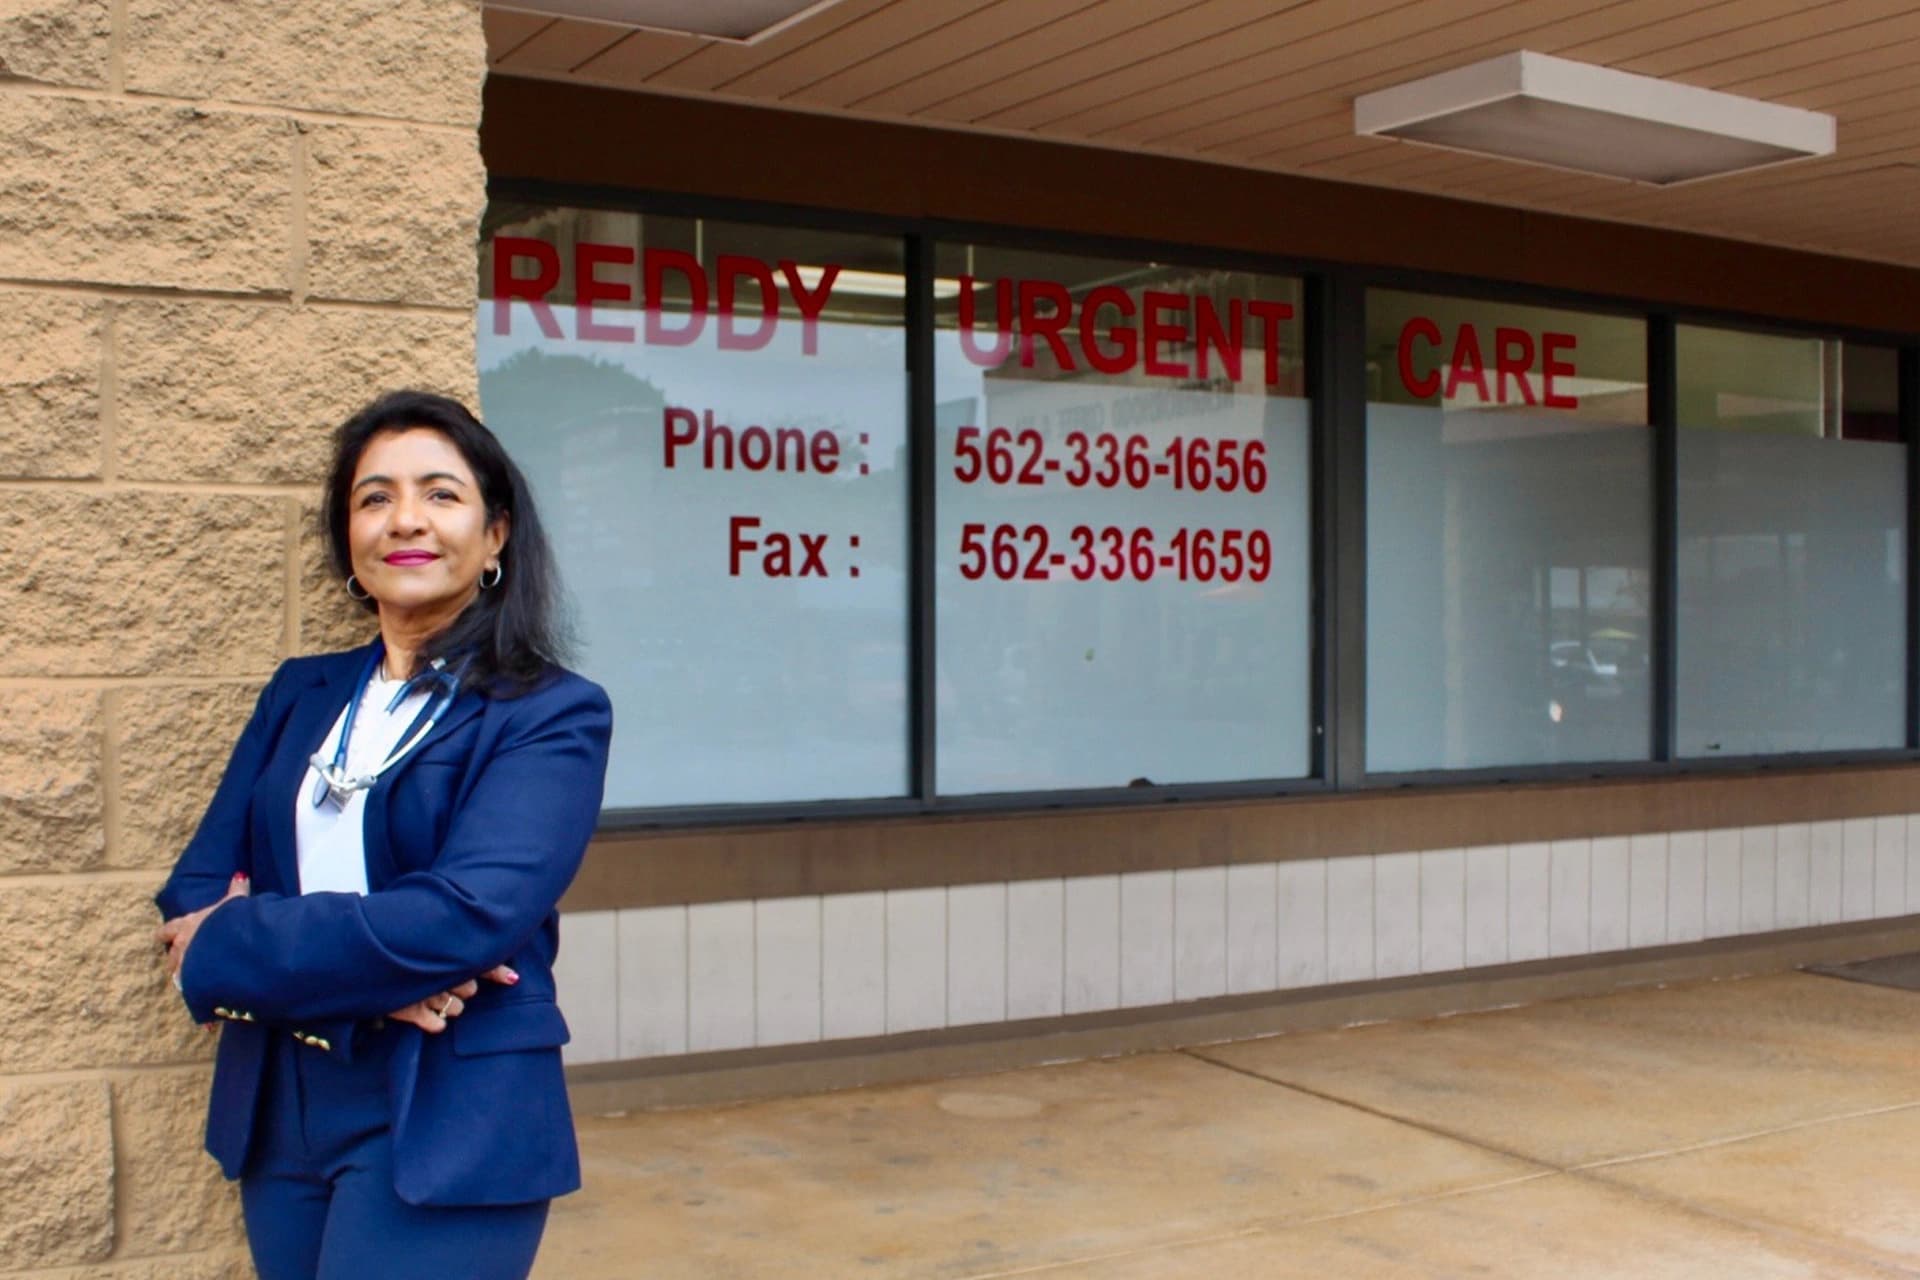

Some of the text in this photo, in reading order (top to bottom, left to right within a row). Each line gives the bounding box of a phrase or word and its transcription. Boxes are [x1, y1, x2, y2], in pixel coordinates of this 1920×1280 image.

[493, 236, 1578, 409] REDDY URGENT CARE
[664, 407, 840, 474] Phone
[954, 426, 1267, 493] 562-336-1656
[729, 516, 829, 578] Fax
[959, 523, 1272, 582] 562-336-1659
